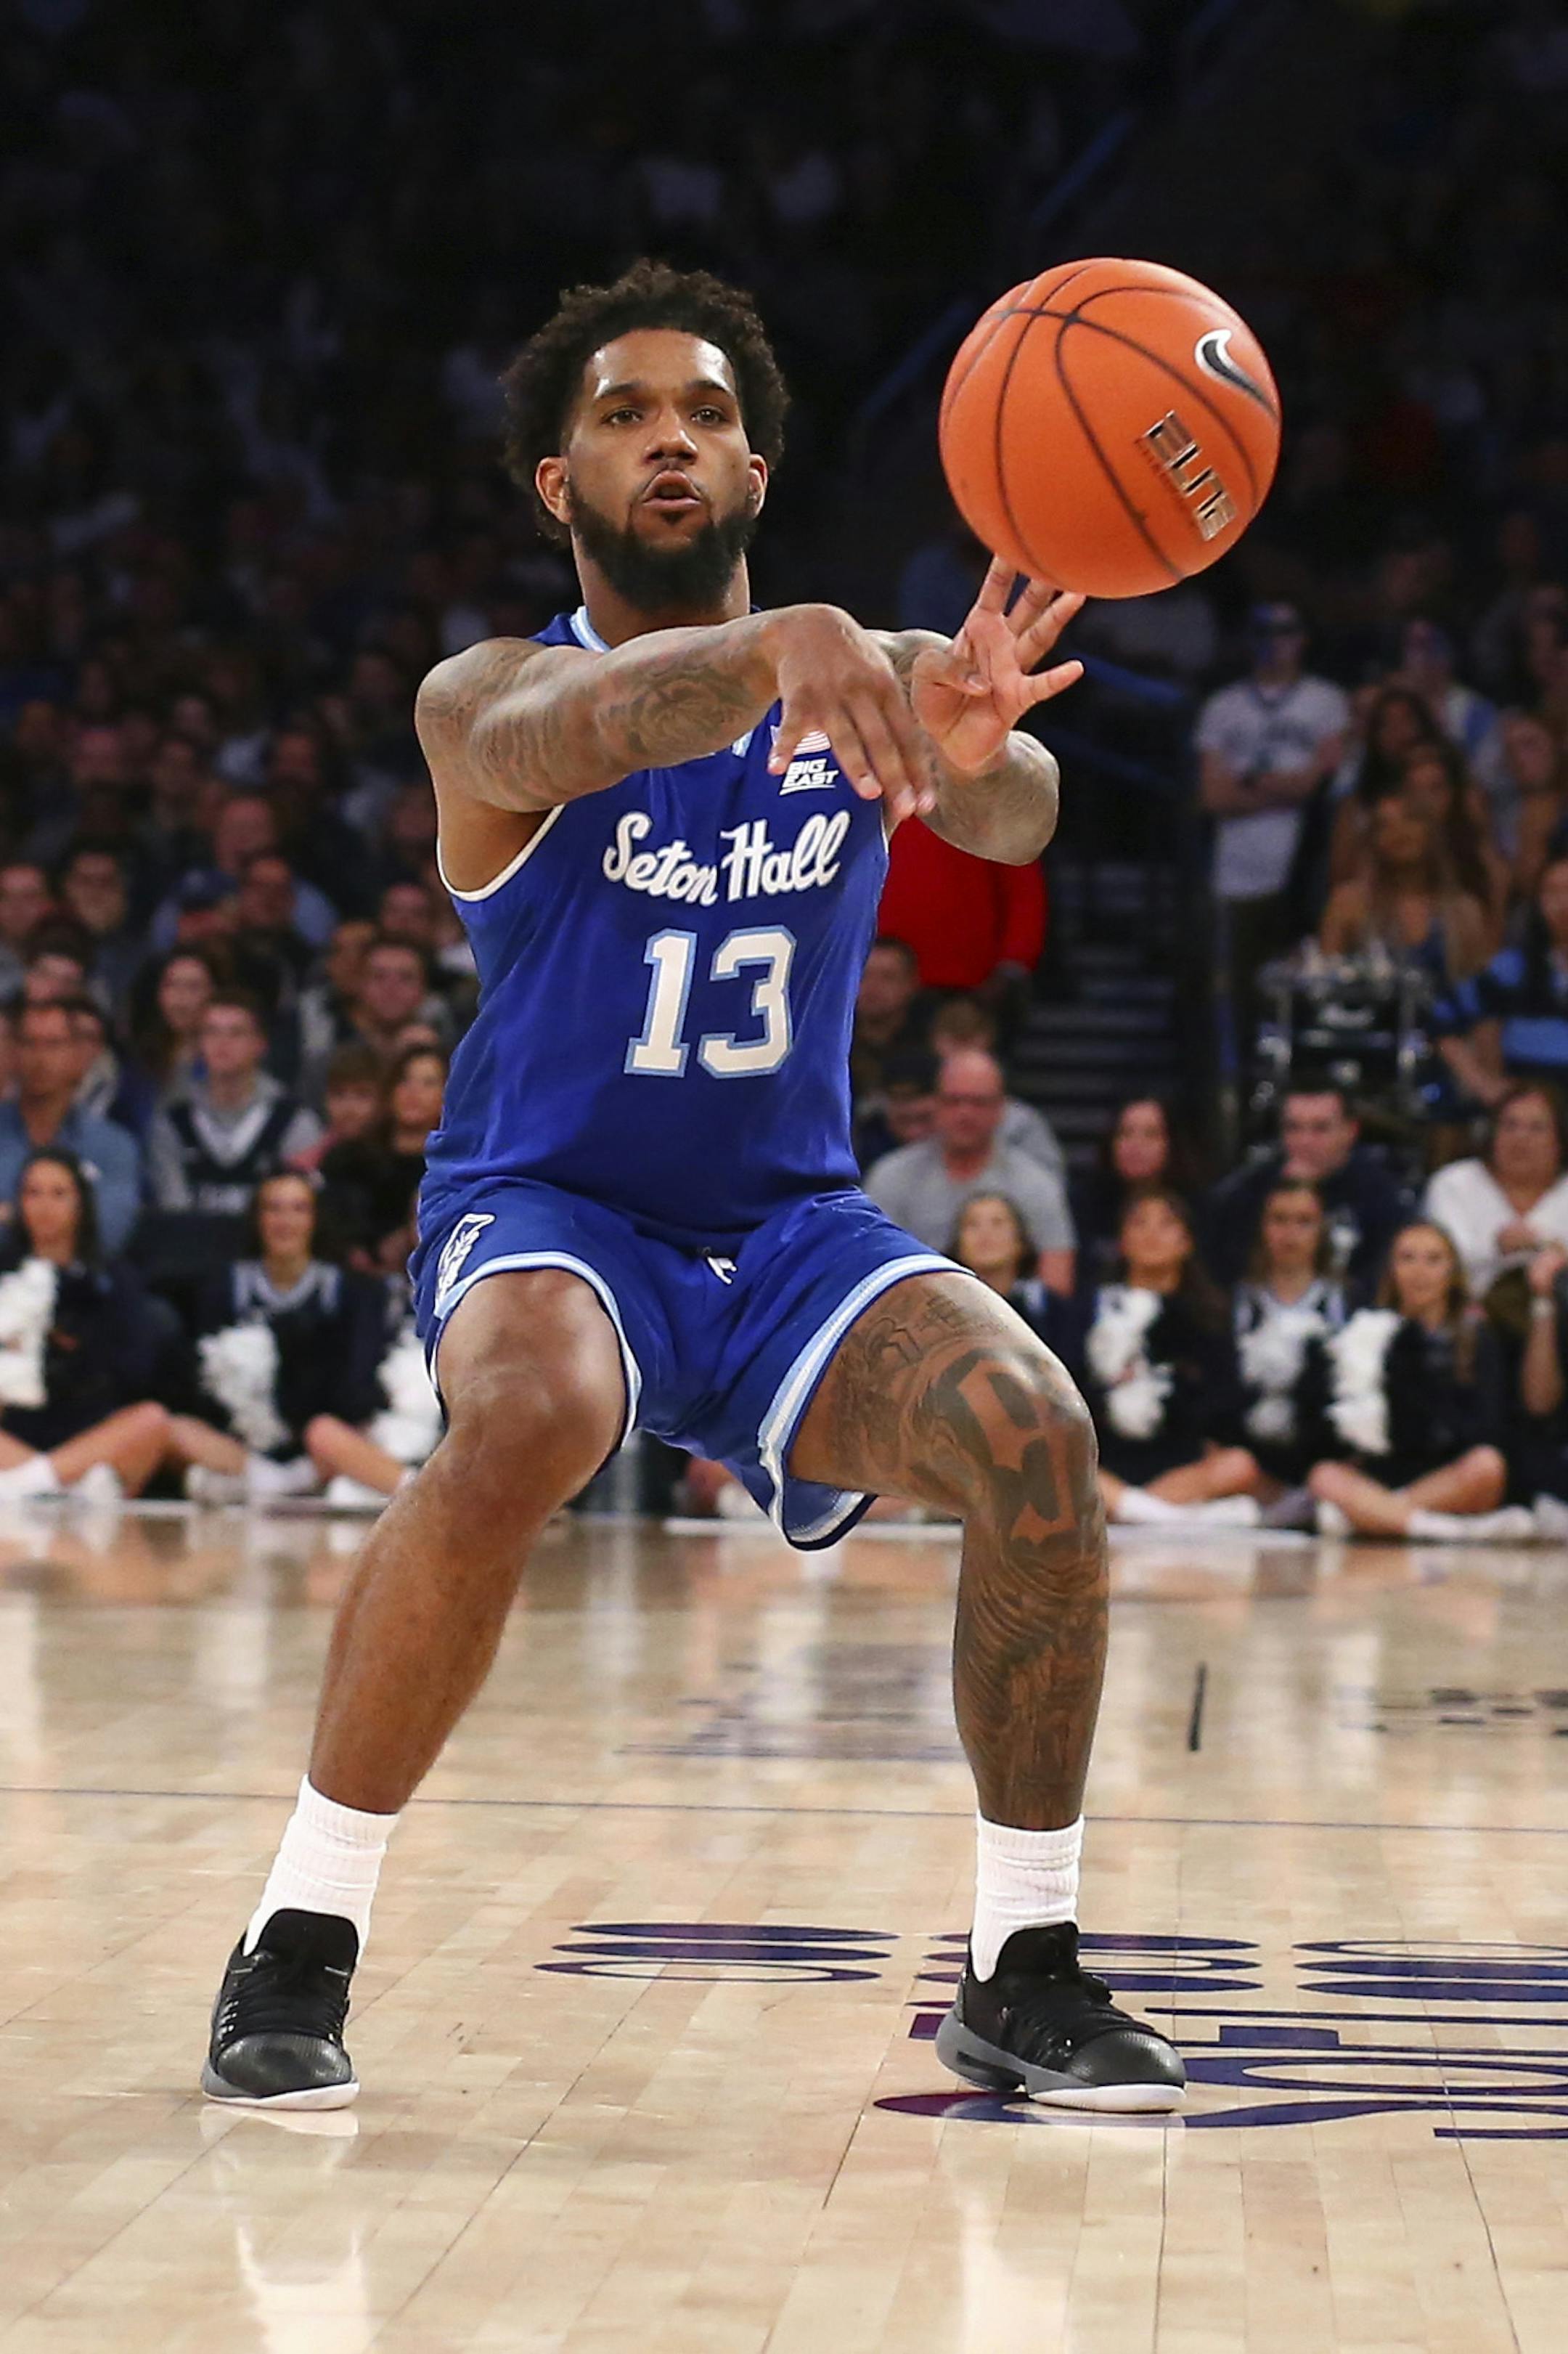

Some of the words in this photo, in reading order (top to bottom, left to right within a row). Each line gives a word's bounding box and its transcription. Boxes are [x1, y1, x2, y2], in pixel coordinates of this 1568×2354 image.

[1143, 410, 1237, 542] ELITE
[782, 770, 839, 789] EAST
[788, 758, 827, 775] BIG
[602, 811, 719, 907] Seton
[719, 808, 851, 903] Hall
[623, 924, 797, 1080] 13
